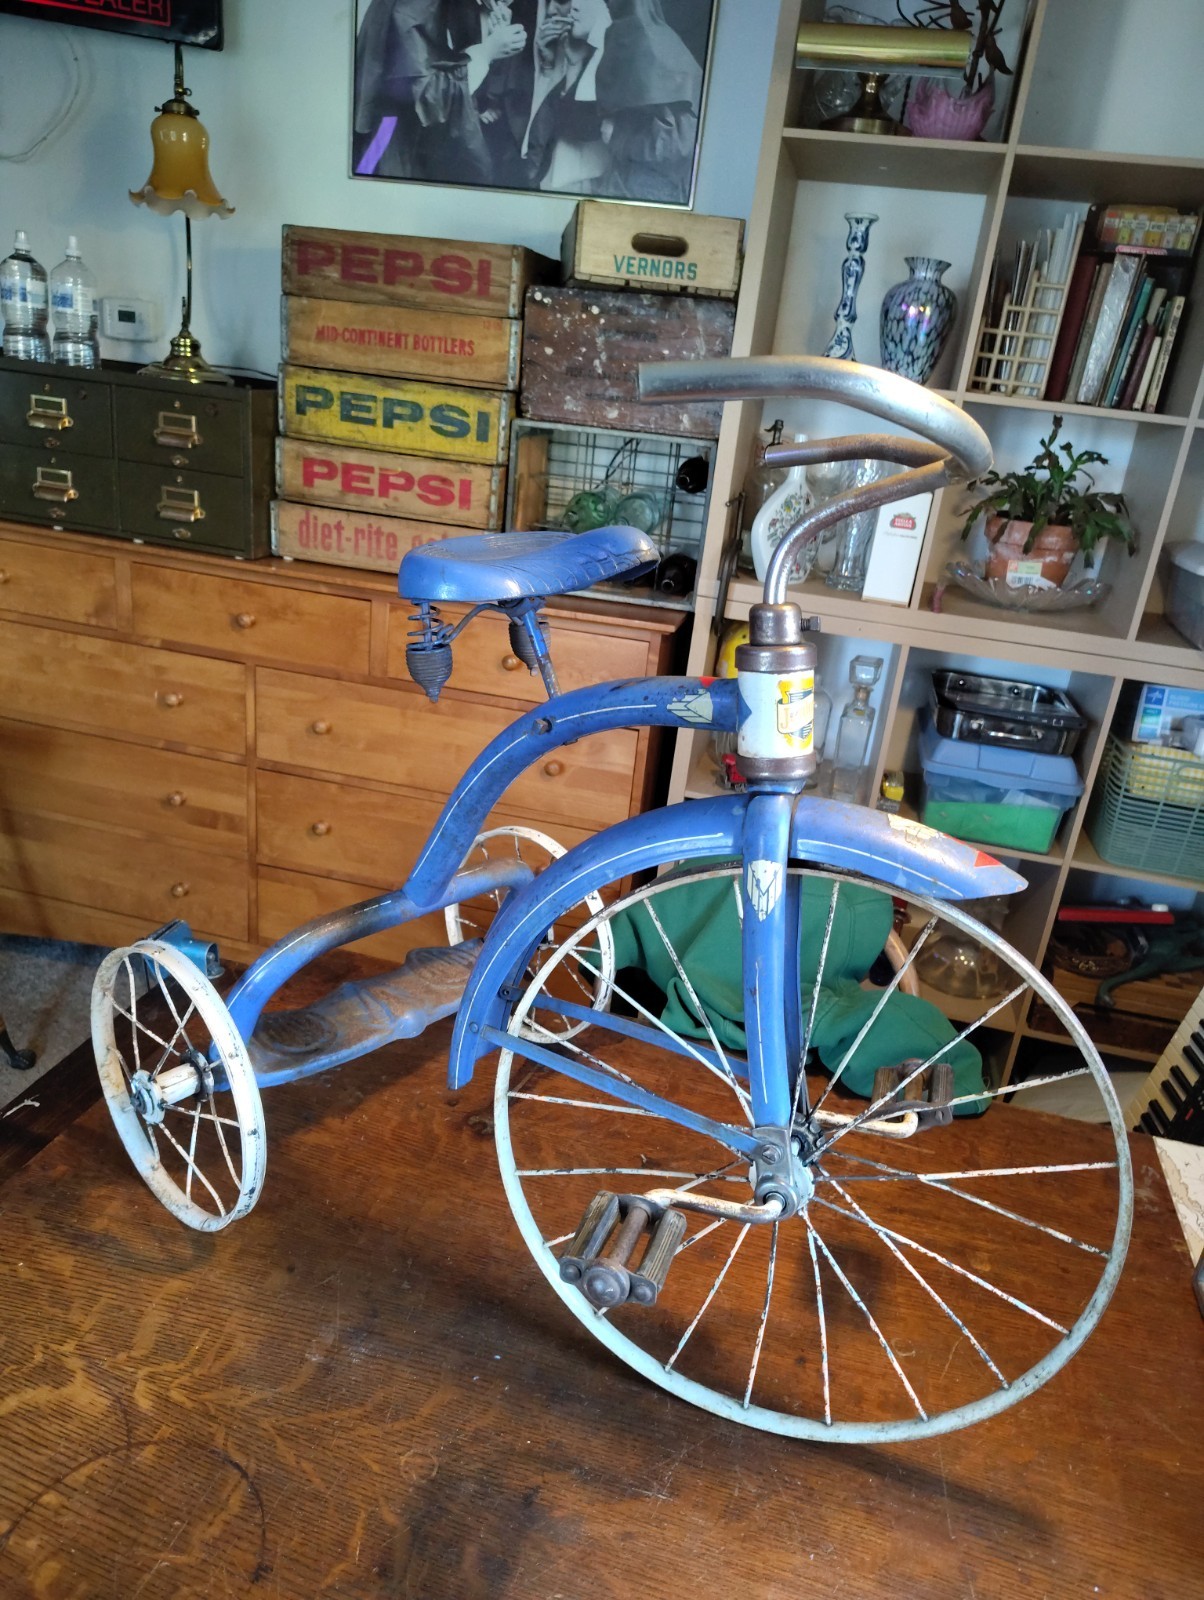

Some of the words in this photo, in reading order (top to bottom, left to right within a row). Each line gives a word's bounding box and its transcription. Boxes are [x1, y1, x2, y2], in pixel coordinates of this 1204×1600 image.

[297, 239, 492, 297] PEPSI
[613, 254, 698, 281] VERNORS
[315, 325, 409, 350] MID-CONTINENT
[413, 333, 475, 357] BOTTLERS
[295, 383, 490, 443] PEPSI
[302, 457, 473, 511] PEPSI
[298, 510, 399, 561] diet-rite
